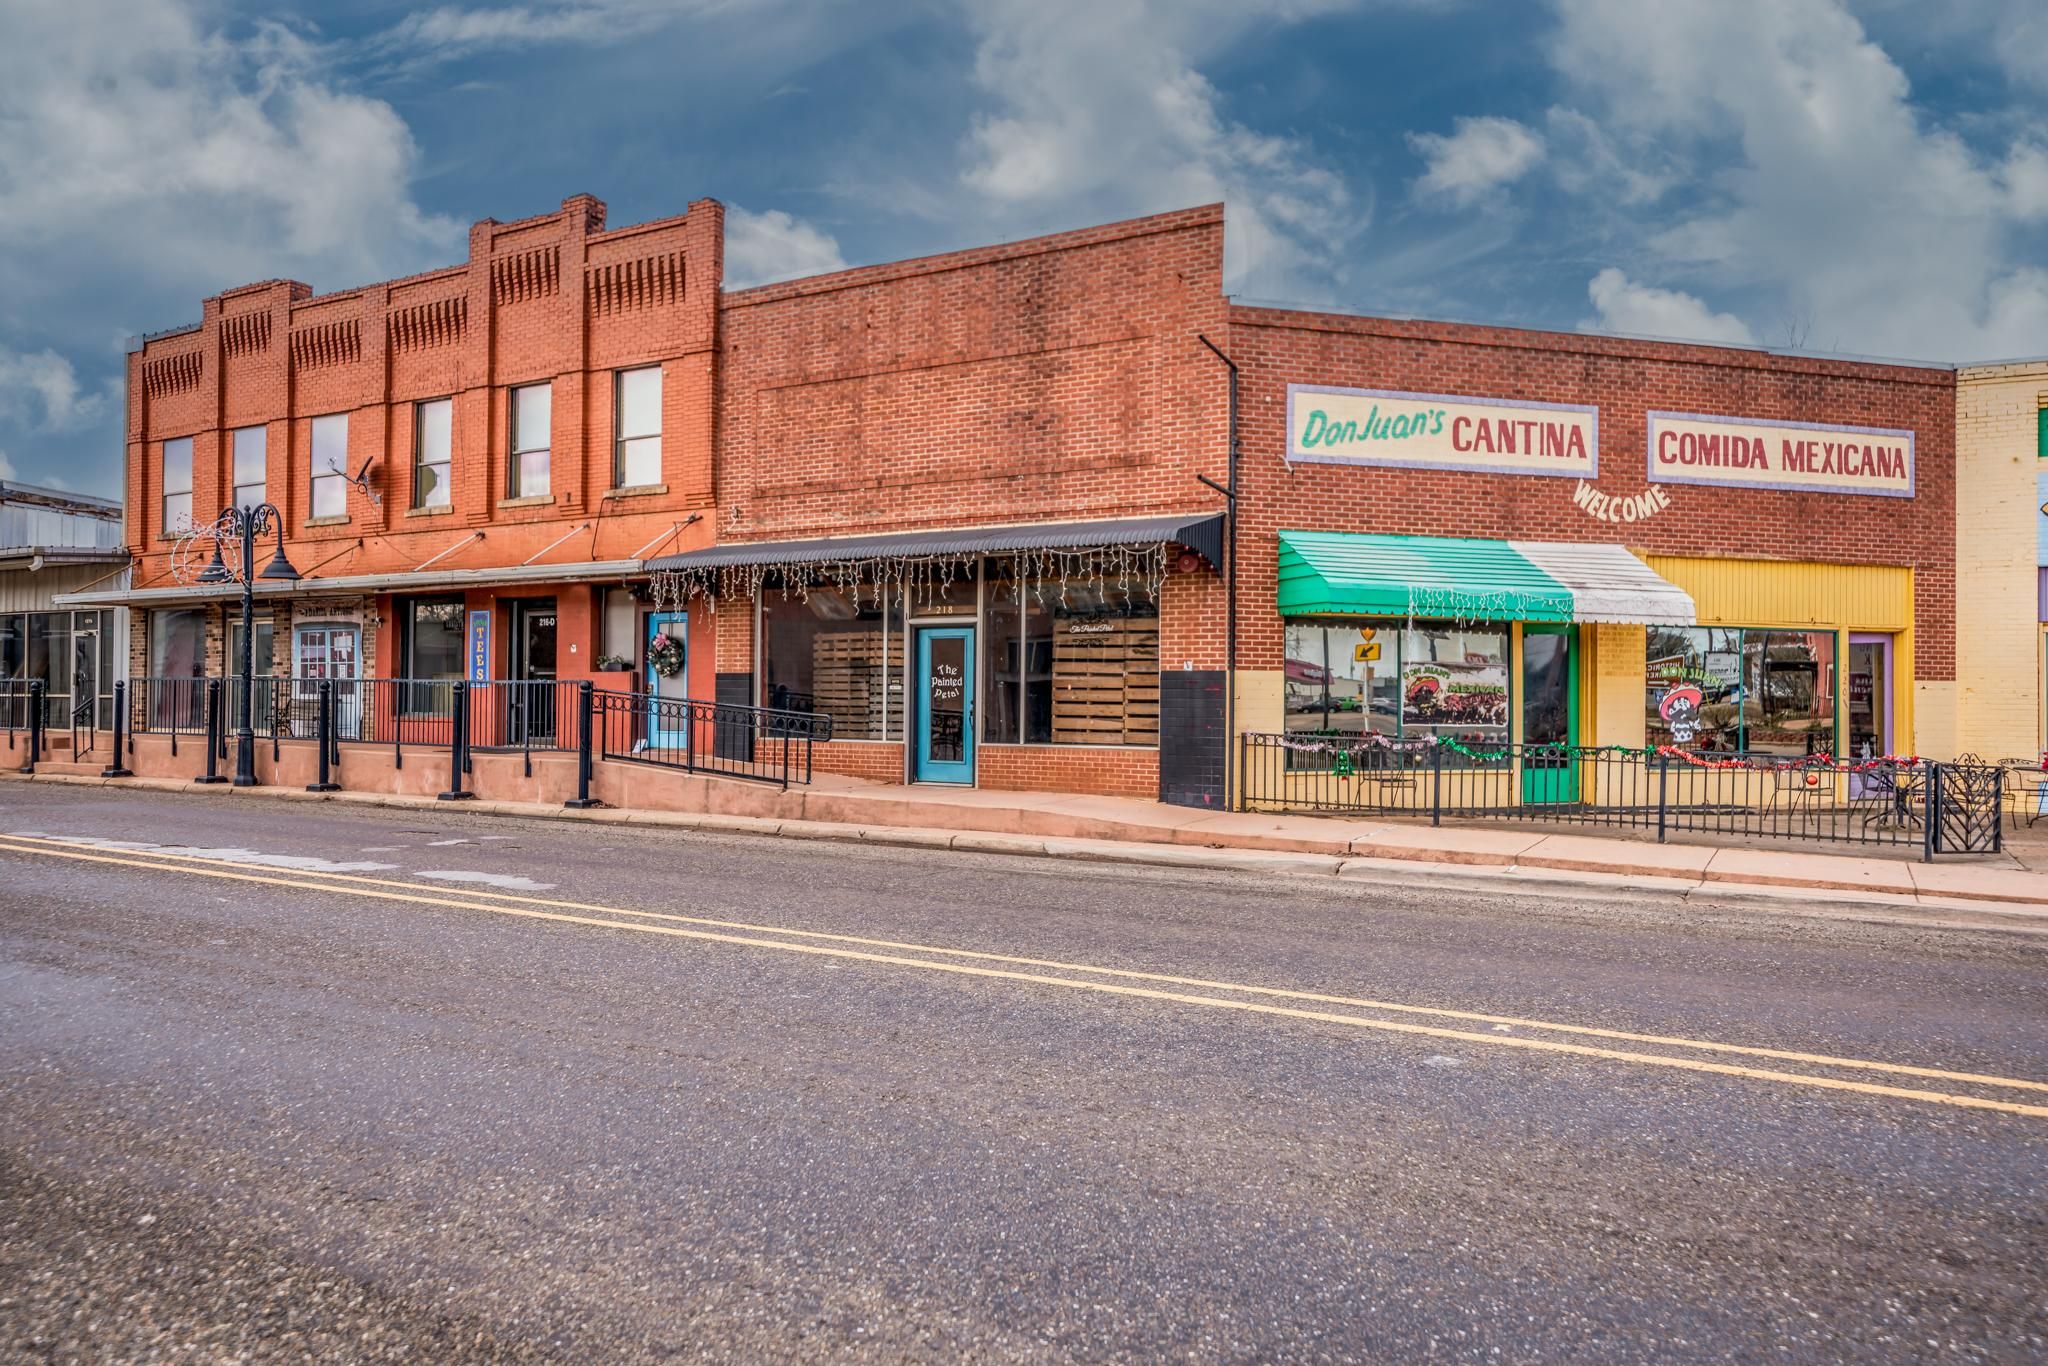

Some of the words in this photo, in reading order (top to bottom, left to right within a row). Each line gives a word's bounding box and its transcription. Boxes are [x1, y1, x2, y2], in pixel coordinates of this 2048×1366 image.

[1452, 415, 1588, 459] CANTINA
[1658, 430, 1769, 470] COMIDA
[1782, 439, 1907, 480] MEXICANA
[1572, 479, 1673, 523] WELCOME
[936, 606, 953, 614] 218
[476, 627, 484, 680] TEES
[937, 664, 958, 675] The
[1661, 666, 1687, 680] DON
[931, 676, 963, 688] Painted
[934, 688, 960, 699] Petal
